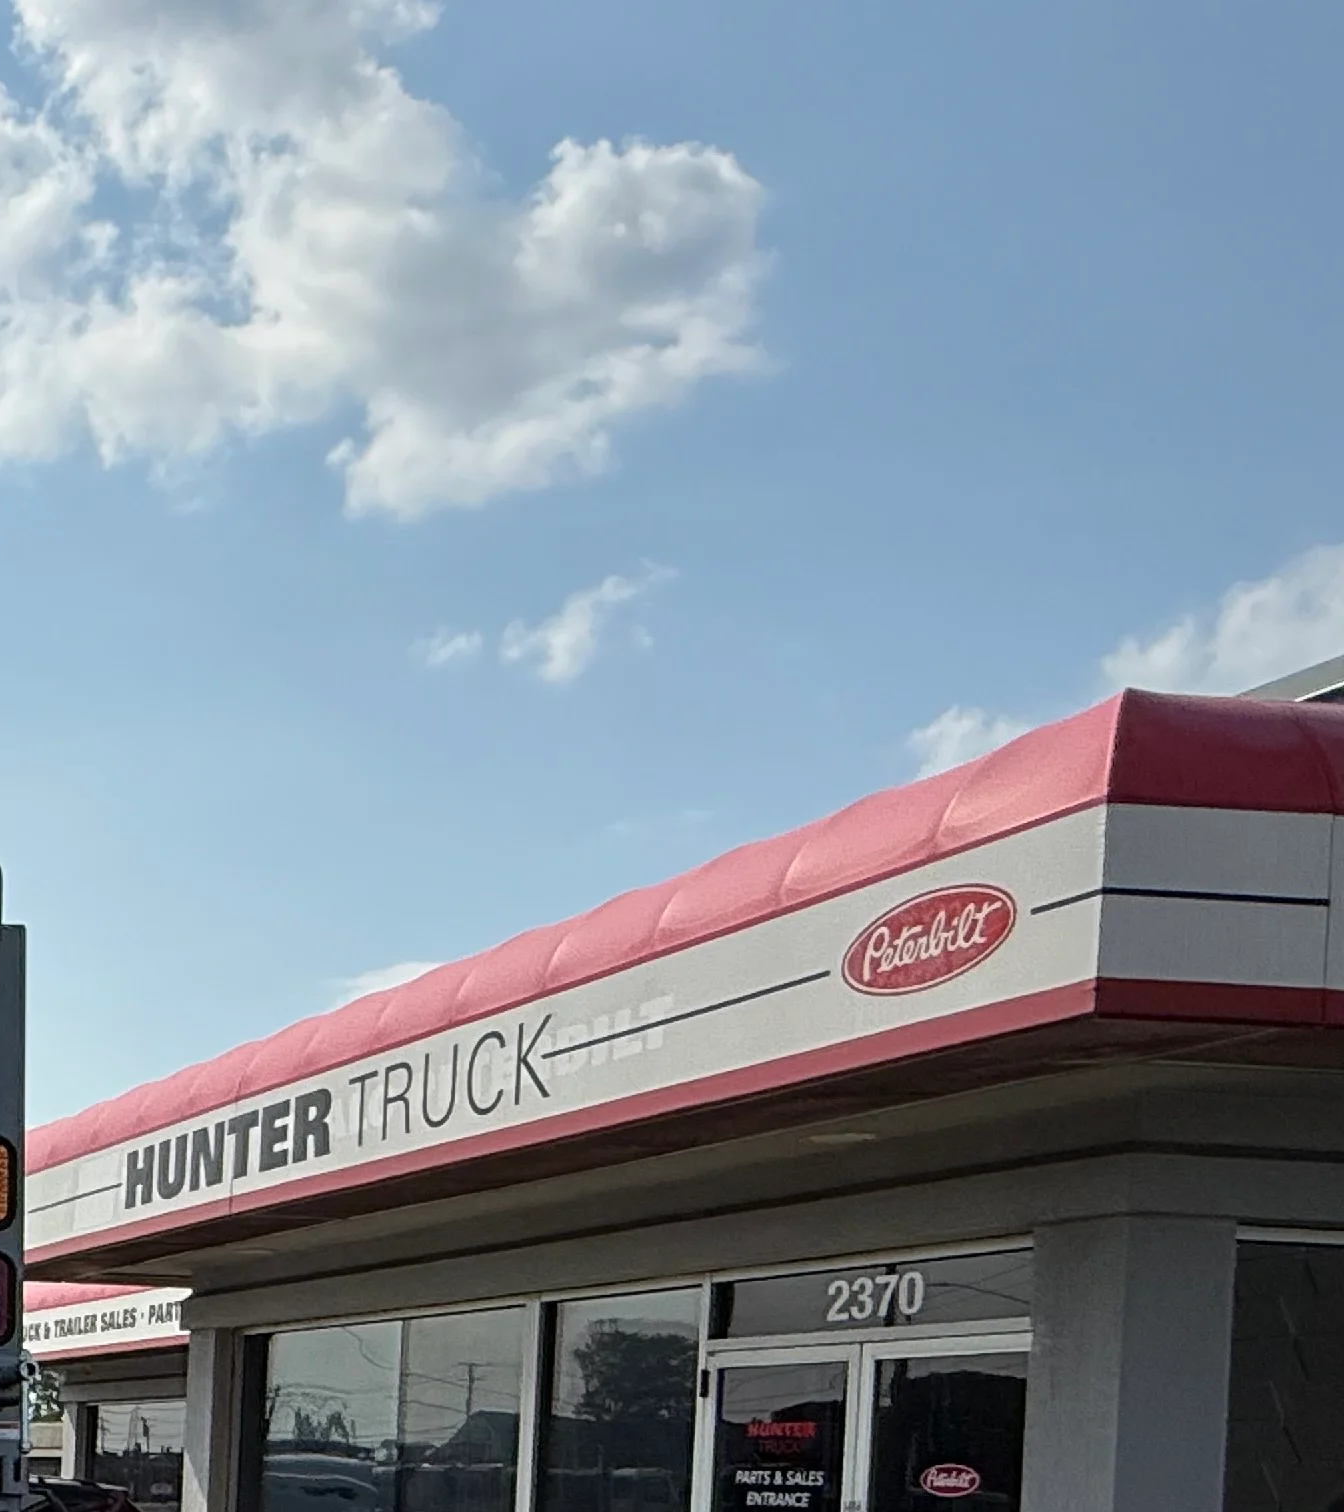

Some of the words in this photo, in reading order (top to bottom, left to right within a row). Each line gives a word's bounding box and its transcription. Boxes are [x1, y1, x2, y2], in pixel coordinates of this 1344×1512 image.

[863, 901, 1002, 982] Peterbilt
[124, 1088, 332, 1209] HUNTER
[349, 1014, 553, 1147] TRUCK
[826, 1271, 924, 1321] 2370
[44, 1321, 51, 1340] &
[54, 1312, 98, 1338] TRAILER
[100, 1306, 138, 1332] SALES
[746, 1422, 815, 1437] HUNTER
[735, 1470, 772, 1486] PARTS
[773, 1470, 783, 1486] &
[785, 1470, 825, 1486] SALES
[746, 1491, 811, 1508] ENTRANCE
